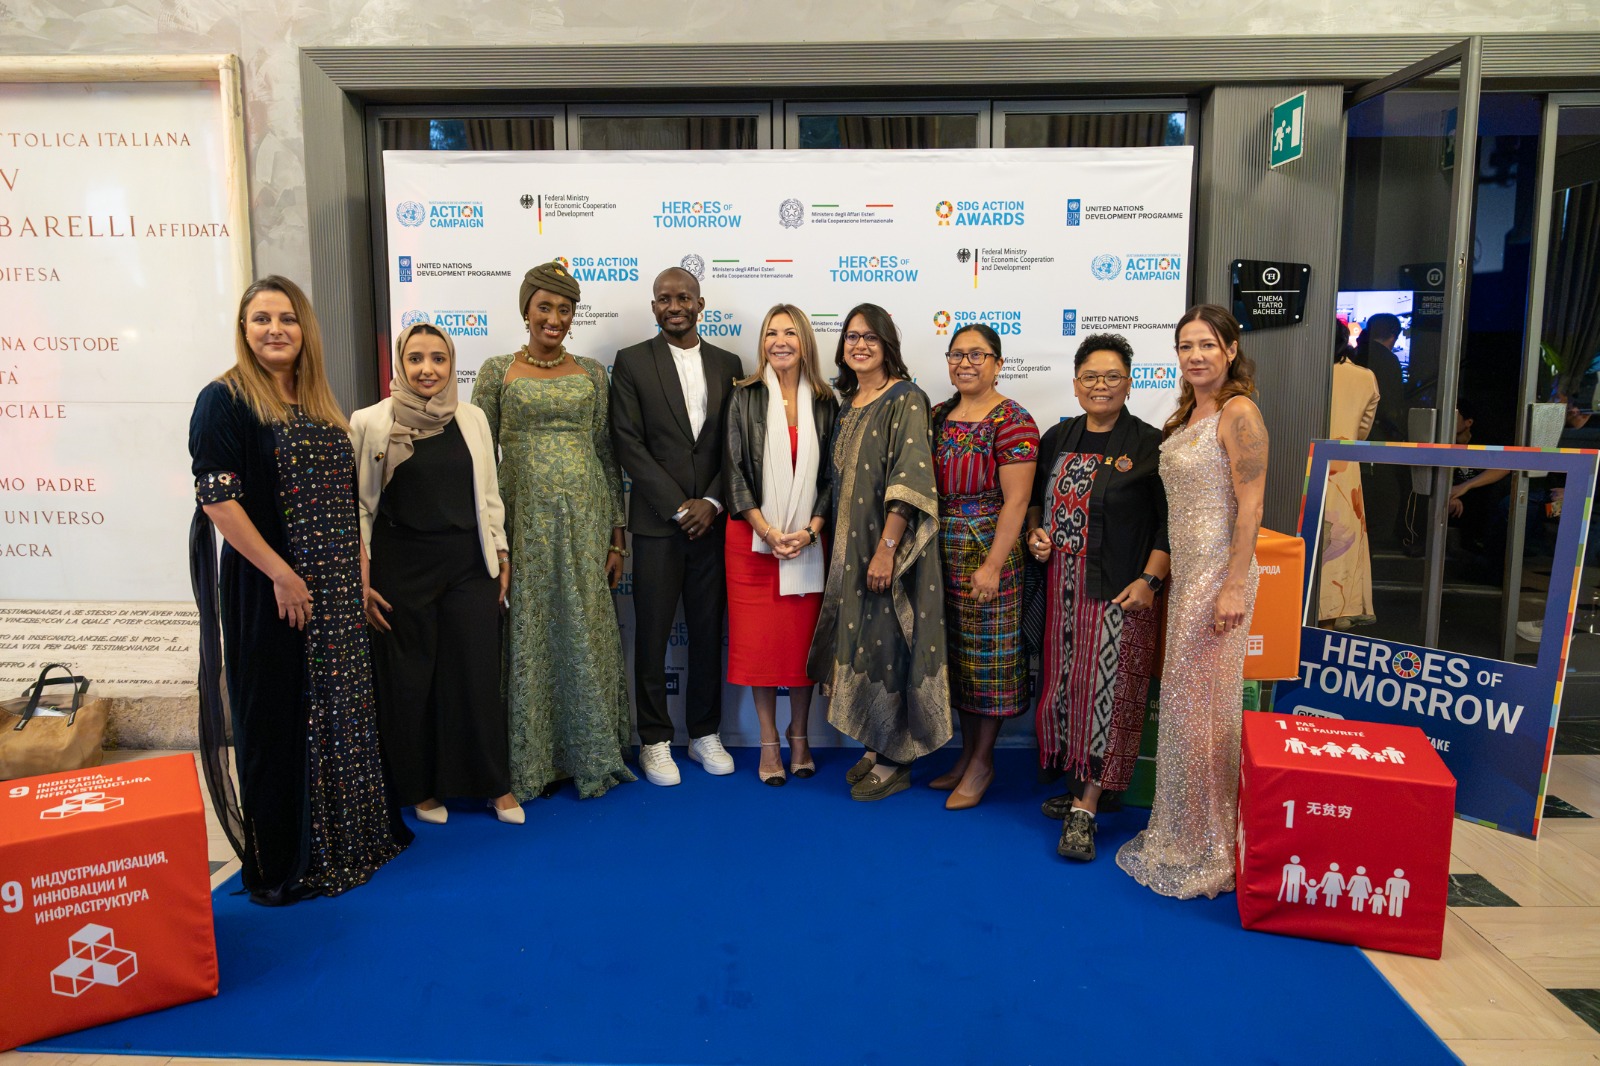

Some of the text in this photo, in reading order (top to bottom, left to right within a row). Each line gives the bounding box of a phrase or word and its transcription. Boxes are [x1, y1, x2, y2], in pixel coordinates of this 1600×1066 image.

[0, 132, 191, 147] TOLICA ITALIANA
[566, 194, 590, 202] Ministry
[430, 205, 484, 218] ACTION
[582, 202, 617, 210] Cooperation
[662, 201, 721, 214] HEROES
[956, 201, 1025, 211] SDG ACTION
[557, 210, 595, 218] Development
[955, 212, 1025, 226] AWARDS
[430, 219, 484, 228] CAMPAIGN
[653, 215, 742, 228] TOMORROW
[146, 223, 230, 237] AFFIDATA
[1004, 248, 1028, 256] Ministry
[572, 257, 638, 267] SDG ACTION
[839, 255, 898, 268] HEROES
[1020, 256, 1054, 264] Cooperation
[1126, 258, 1181, 270] ACTION
[993, 264, 1031, 272] Development
[0, 268, 60, 282] IFESA
[572, 268, 639, 282] AWARDS
[830, 269, 919, 282] TOMORROW
[1125, 271, 1180, 281] CAMPAIGN
[585, 311, 619, 319] Cooperation
[954, 311, 1021, 321] SDG ACTION
[33, 336, 120, 351] CUSTODE
[1016, 364, 1052, 372] Cooperation
[0, 404, 67, 419] CIALE
[37, 478, 97, 492] PADRE
[5, 510, 105, 525] UNIVERSO
[1321, 634, 1504, 689] HEROES OF
[1300, 661, 1525, 735] TOMORROW
[1275, 719, 1288, 730] 1
[1312, 728, 1365, 737] PAUVRETÉ
[9, 786, 30, 798] 9
[35, 776, 152, 800] INFRAESTRUCTURA
[1282, 799, 1353, 829] 1 无贫穷
[31, 851, 169, 890] ИНДУСТРИАЛИЗАЦИЯ,
[1, 880, 24, 913] 9
[32, 876, 128, 908] ИННОВАЦИИ И
[34, 888, 150, 926] ИНФРАСТРУКТУРА
